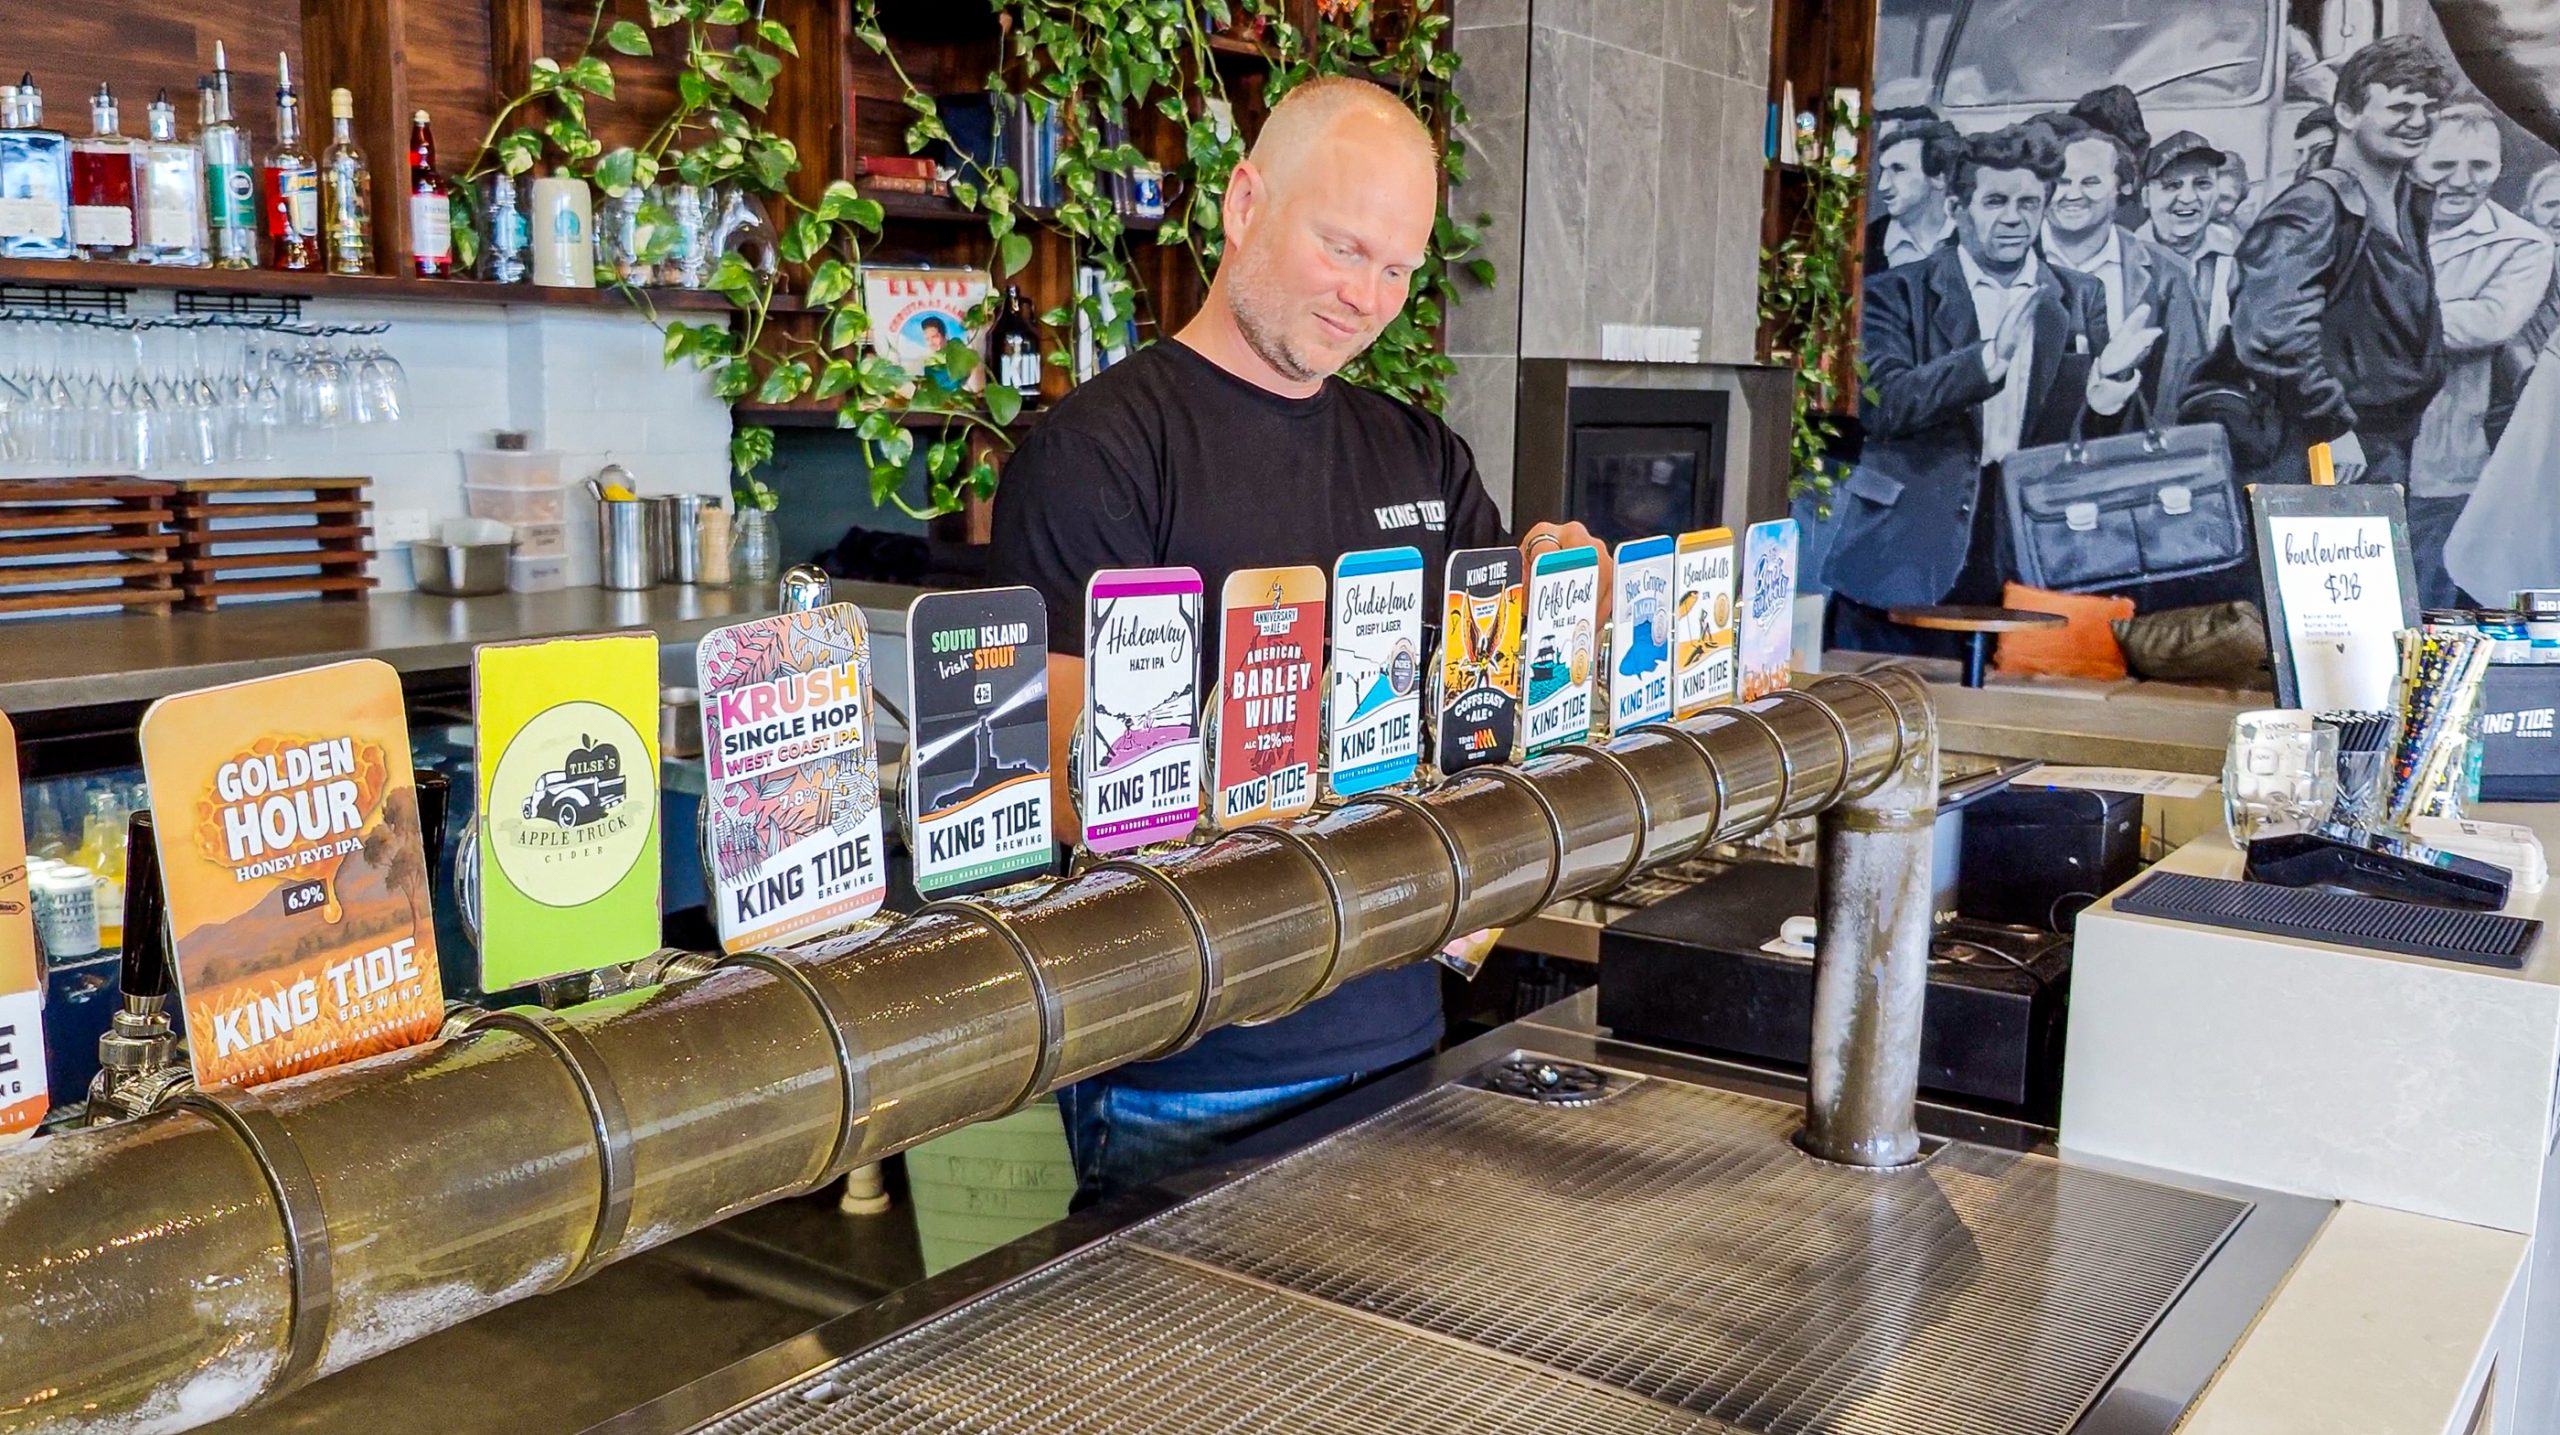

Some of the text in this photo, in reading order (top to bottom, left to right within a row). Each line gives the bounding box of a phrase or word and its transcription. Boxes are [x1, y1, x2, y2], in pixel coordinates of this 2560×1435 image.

[887, 277, 969, 297] ELVIS
[1374, 500, 1446, 530] KING TID
[2285, 528, 2386, 566] boulevardier
[1466, 561, 1508, 586] KING TIDE
[1255, 609, 1297, 624] ANNIVERSARY
[1356, 620, 1402, 637] CRISPY LAGER
[1553, 615, 1576, 629] PALE ALE
[931, 622, 1028, 653] SOUTH ISLAND
[938, 645, 1016, 680] Irish STOUT
[1129, 656, 1165, 672] HAZY IPA
[1246, 645, 1301, 666] AMERICAN
[1232, 662, 1312, 701] BARLEY
[1682, 659, 1728, 699] KING TIDE
[720, 664, 858, 730] KRUSH
[1245, 694, 1297, 729] WINE
[1454, 692, 1506, 717] COFFS EASY
[1619, 676, 1666, 719] KING TIDE
[724, 703, 858, 756] SINGLE HOP
[1531, 693, 1586, 738] KING TIDE
[2518, 709, 2555, 730] TIDE
[726, 727, 861, 776] WEST COAST IPA
[1243, 732, 1294, 752] ALC 12% VOL
[1340, 713, 1411, 762] KING TIDE
[216, 736, 356, 803] GOLDEN
[779, 788, 819, 811] 7.8%
[1098, 760, 1191, 815] KING TIDE
[1227, 765, 1307, 815] KING TIDE
[223, 779, 364, 862] HOUR
[518, 814, 628, 847] APPLE TRUCK
[929, 797, 1041, 864] KING TIDE
[234, 836, 366, 883] HONEY RYE IPA
[544, 846, 604, 864] CIDER
[995, 834, 1042, 852] BREWING
[736, 833, 873, 923] KING TIDE
[817, 873, 875, 900] BREWING
[287, 883, 325, 911] 6.9%
[212, 936, 420, 1059] KING TIDE
[338, 983, 424, 1023] BREWING
[353, 1008, 428, 1042] AUSTRALIA
